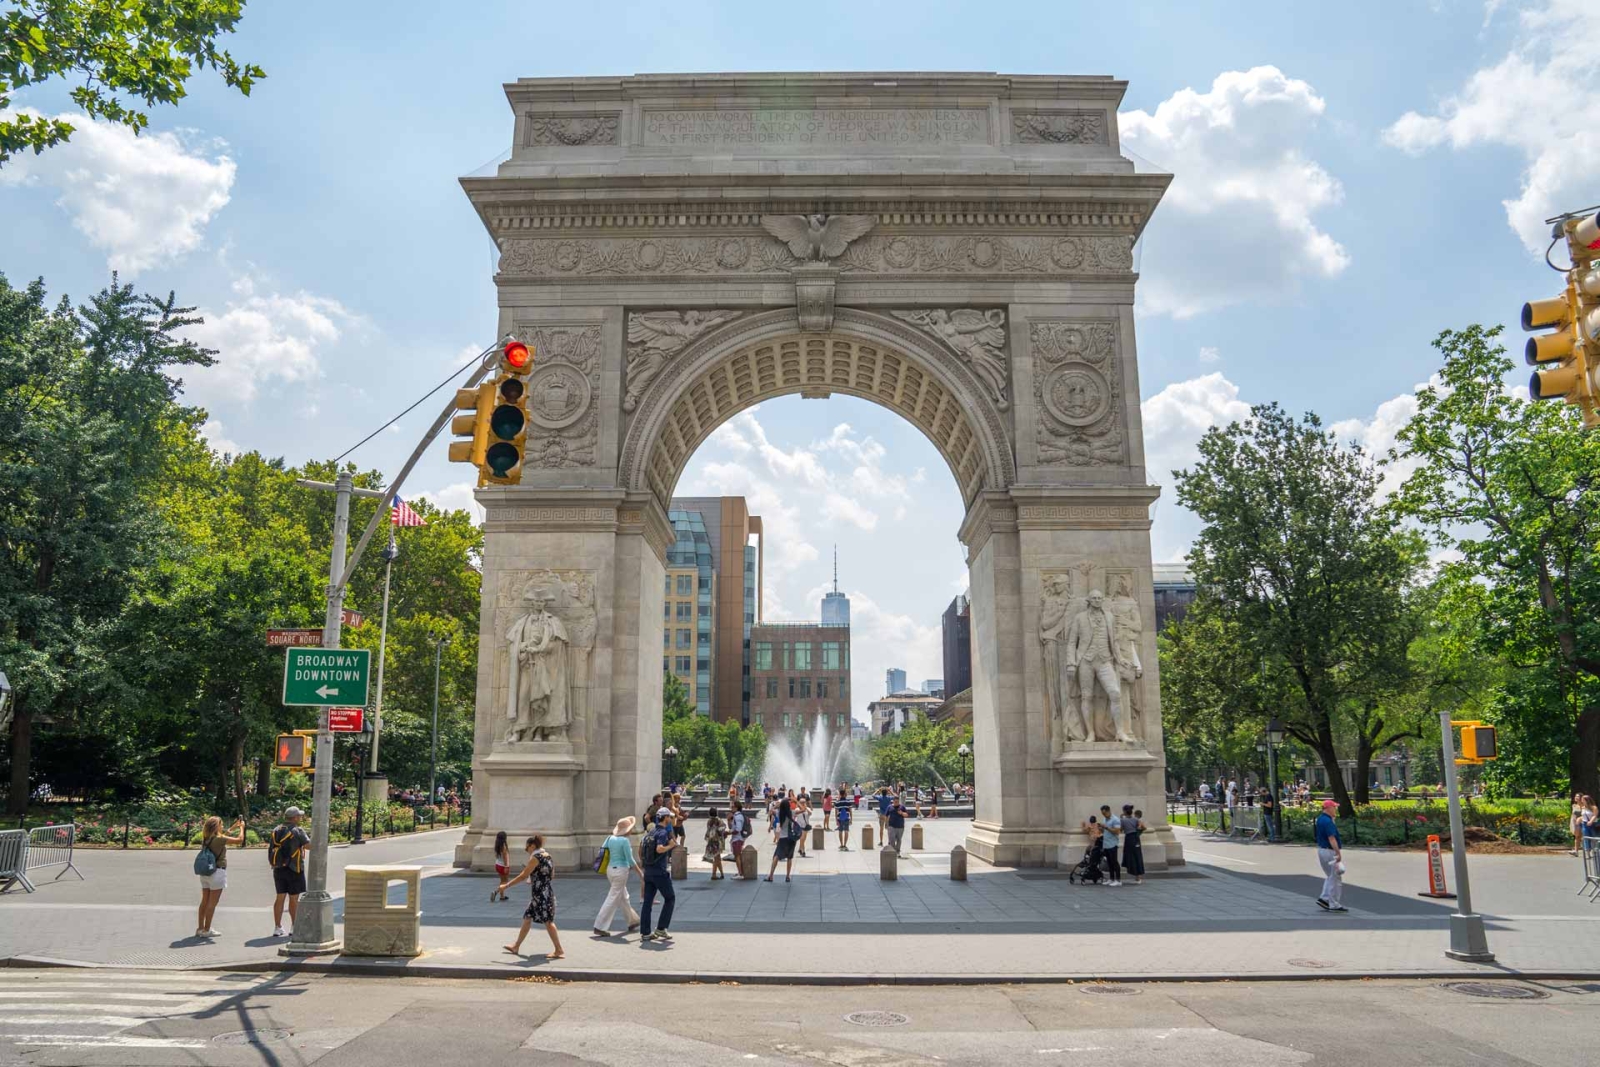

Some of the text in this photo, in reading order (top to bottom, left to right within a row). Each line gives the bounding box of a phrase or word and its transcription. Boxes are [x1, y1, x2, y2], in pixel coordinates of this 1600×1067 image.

[648, 111, 980, 122] TO COMMEMORATE THE ONE HUNDREDTH ANNIVERSARY
[648, 121, 981, 133] OF THE INAUGURATION OF GEORGE WASHINGTON
[659, 133, 676, 143] AS
[682, 133, 718, 143] FIRST
[722, 132, 793, 142] PRESIDENT
[799, 132, 819, 142] OF
[825, 132, 853, 141] THE
[858, 132, 909, 142] UNITED
[597, 249, 616, 261] W
[680, 249, 700, 261] W
[765, 249, 784, 261] W
[850, 248, 867, 261] W
[934, 247, 954, 261] W
[1015, 247, 1035, 261] W
[340, 611, 360, 626] 5 AV
[270, 635, 320, 644] SQUARE NORTH
[297, 655, 359, 667] BROADWAY
[295, 670, 360, 681] DOWNTOWN
